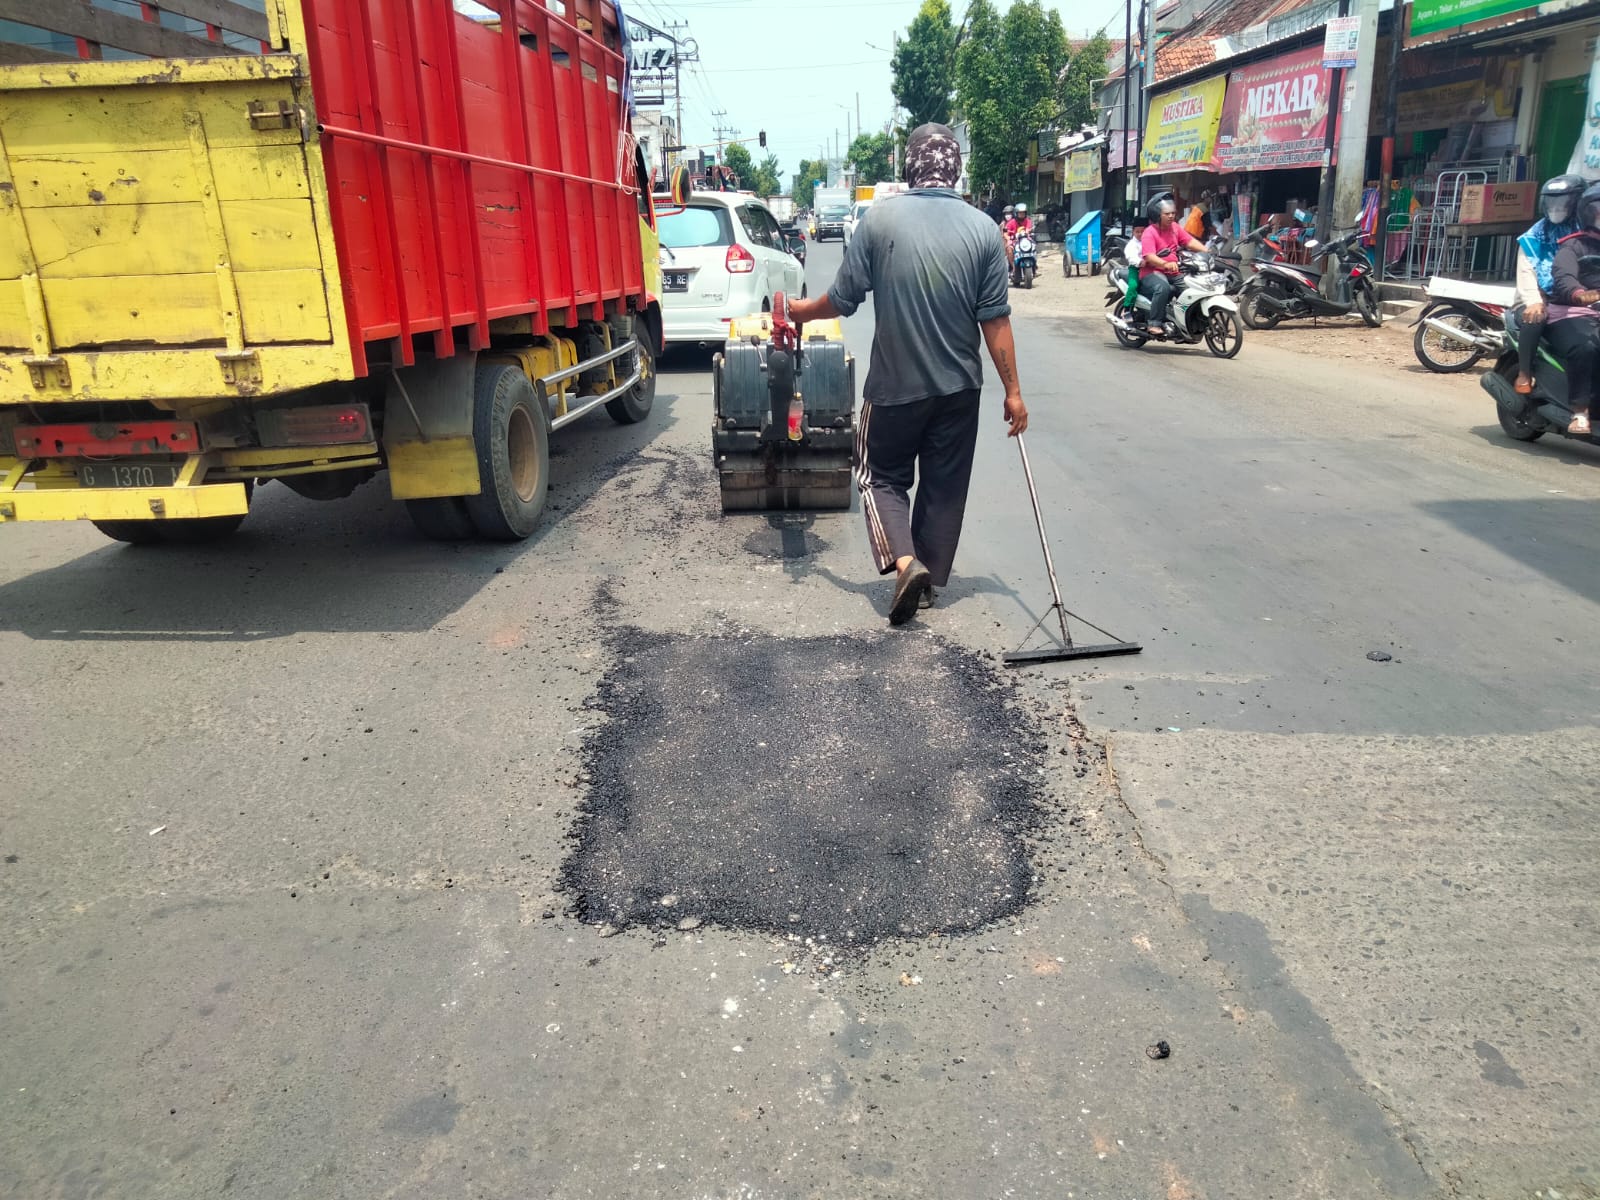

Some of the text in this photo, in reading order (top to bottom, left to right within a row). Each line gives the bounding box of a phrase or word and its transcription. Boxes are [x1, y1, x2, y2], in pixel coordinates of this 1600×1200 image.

[1161, 95, 1204, 124] MUSTIKA
[1245, 74, 1318, 118] MEKAR
[83, 466, 95, 486] G
[111, 466, 154, 487] 1370
